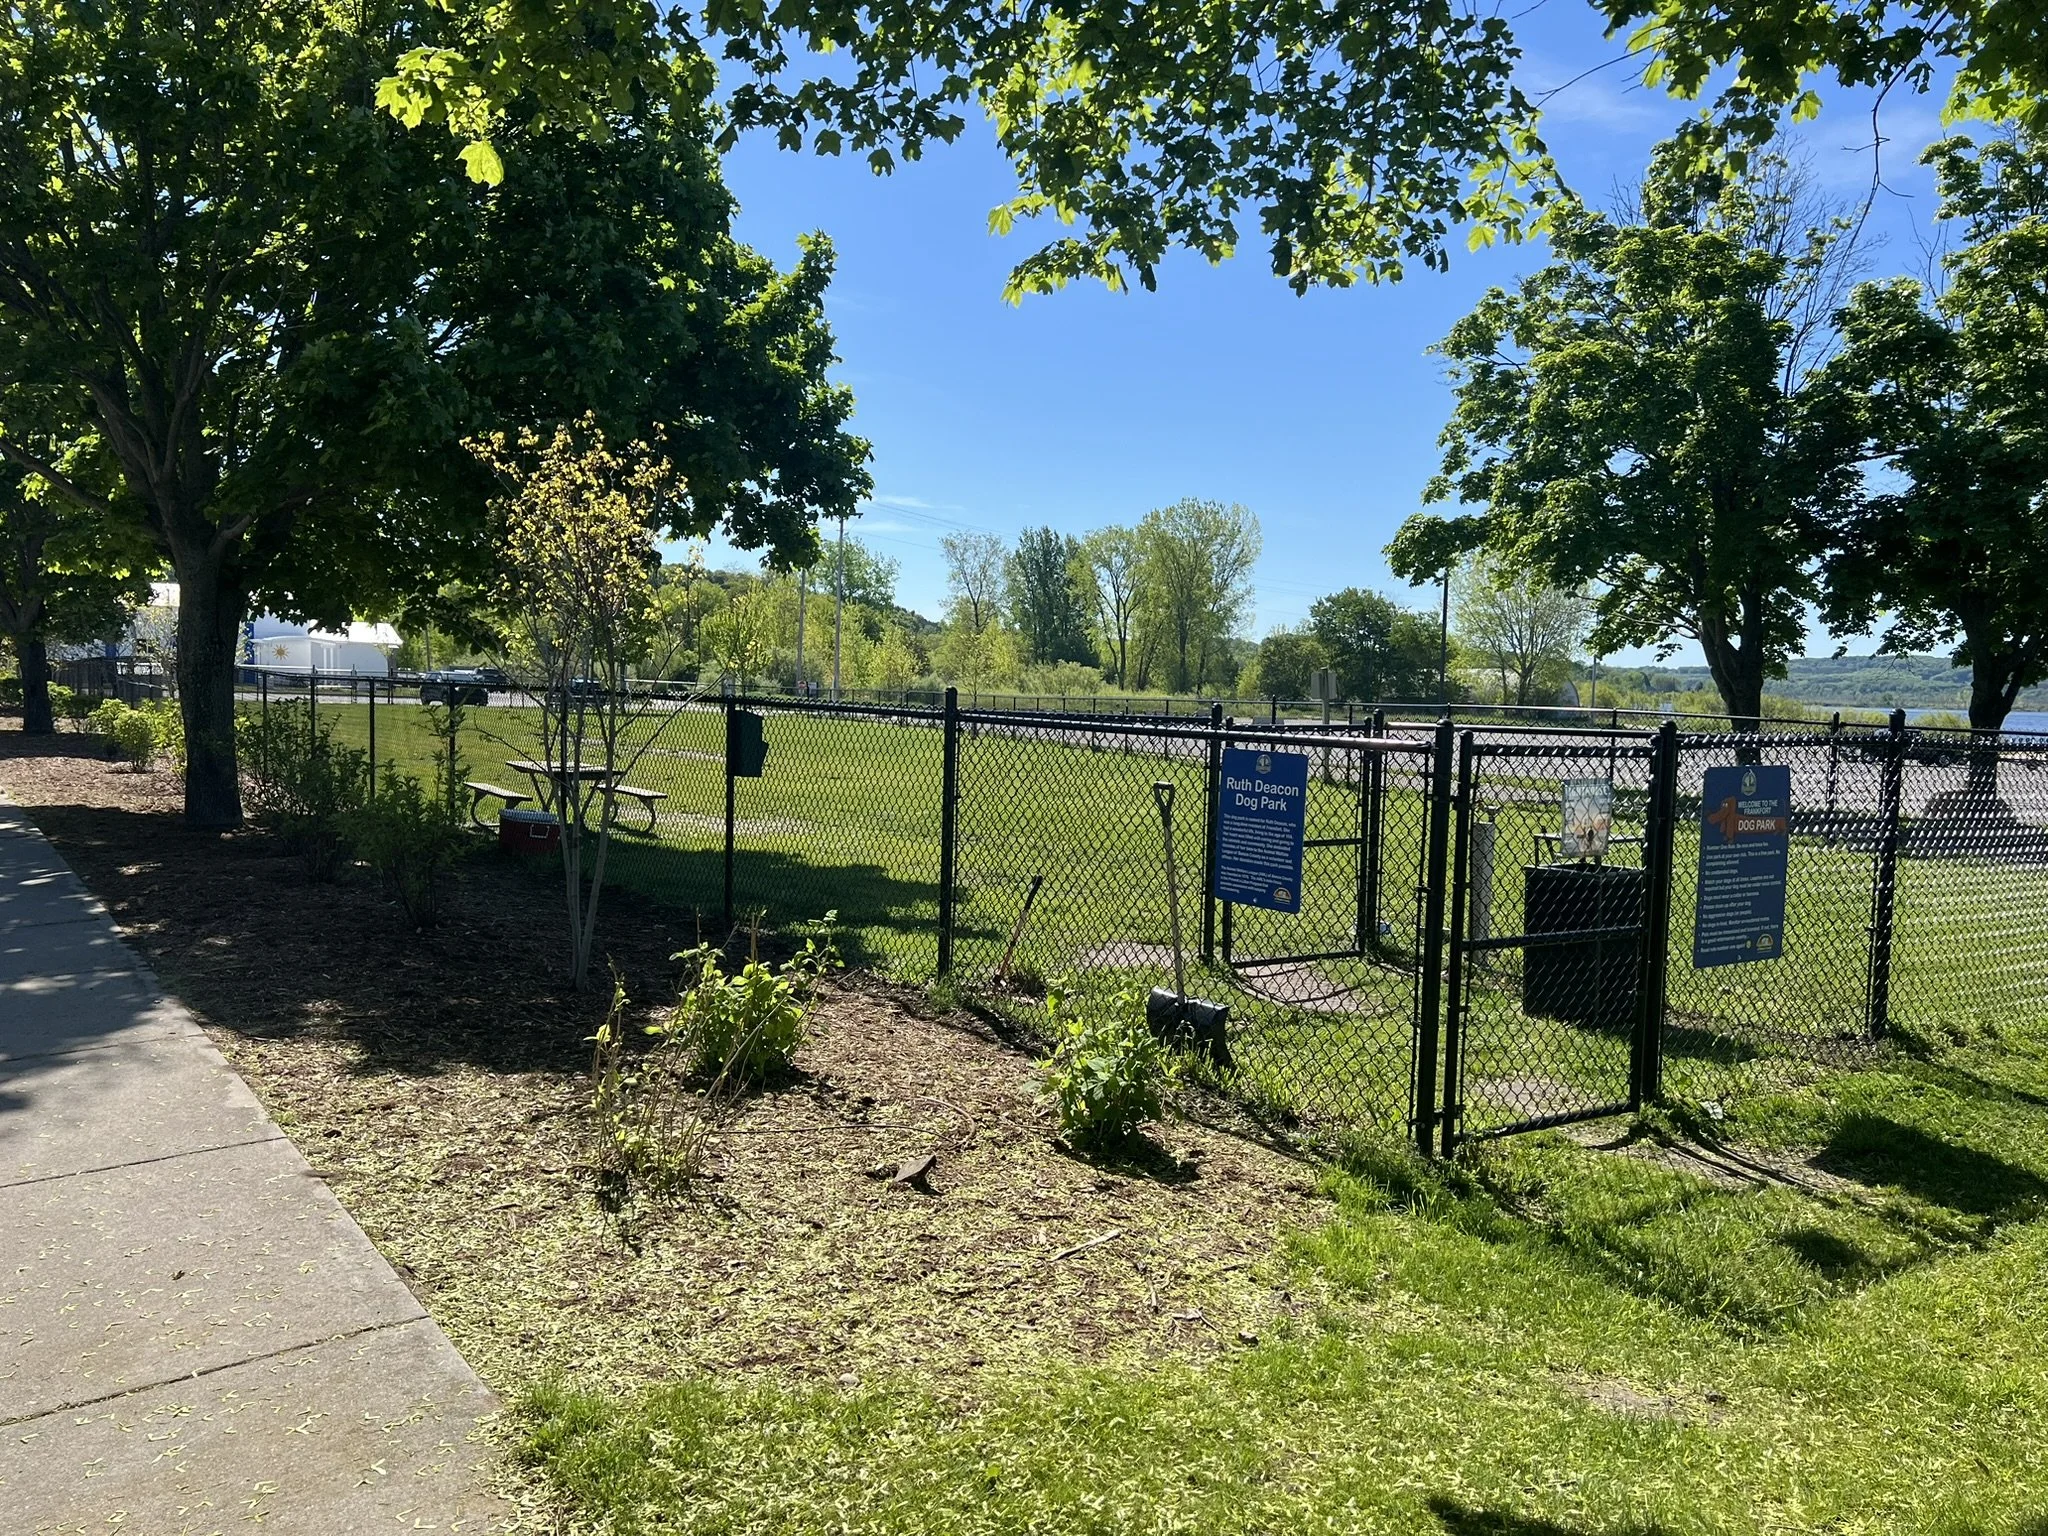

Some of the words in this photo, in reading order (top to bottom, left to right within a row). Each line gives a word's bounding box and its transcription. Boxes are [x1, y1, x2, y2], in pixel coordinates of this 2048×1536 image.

[1226, 777, 1252, 792] Ruth
[1254, 780, 1299, 797] Deacon
[1235, 793, 1258, 811] Dog
[1260, 796, 1287, 812] Park
[1738, 800, 1761, 809] WELCOME
[1761, 800, 1769, 808] TO
[1768, 799, 1778, 807] THE
[1743, 807, 1772, 815] FRANKFORT
[1737, 820, 1755, 831] DOG
[1755, 819, 1776, 831] PARK
